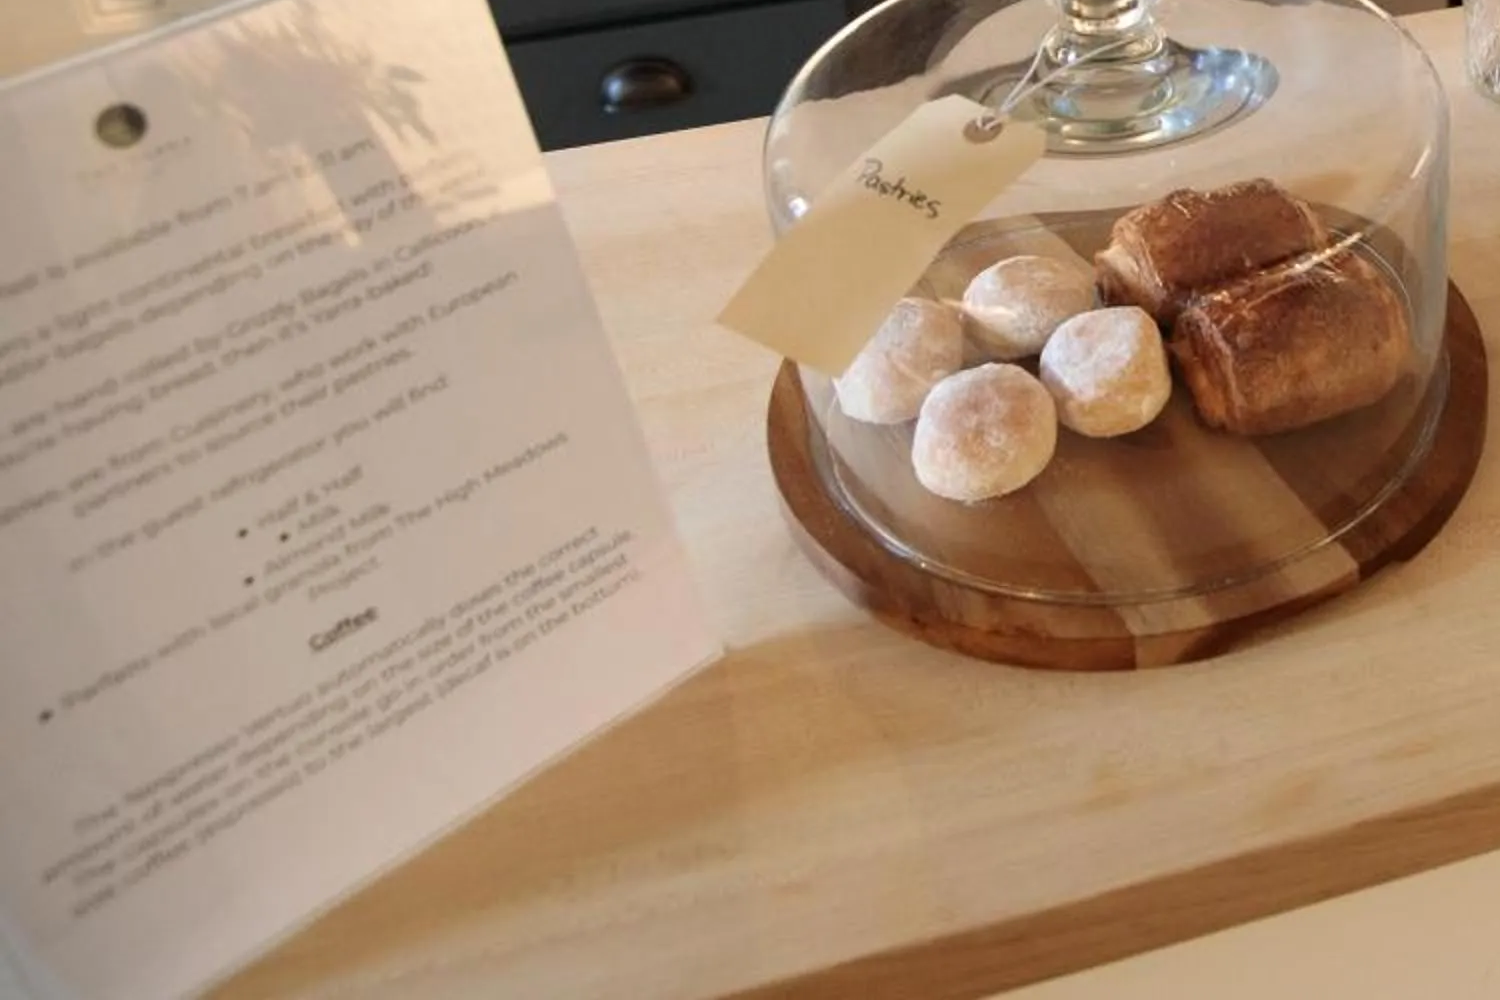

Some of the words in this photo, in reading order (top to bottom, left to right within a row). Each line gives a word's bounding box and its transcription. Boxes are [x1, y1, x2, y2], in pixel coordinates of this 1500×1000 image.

[856, 158, 941, 219] Pastries
[140, 262, 263, 325] depending
[428, 269, 518, 321] European
[308, 605, 378, 653] Coffee
